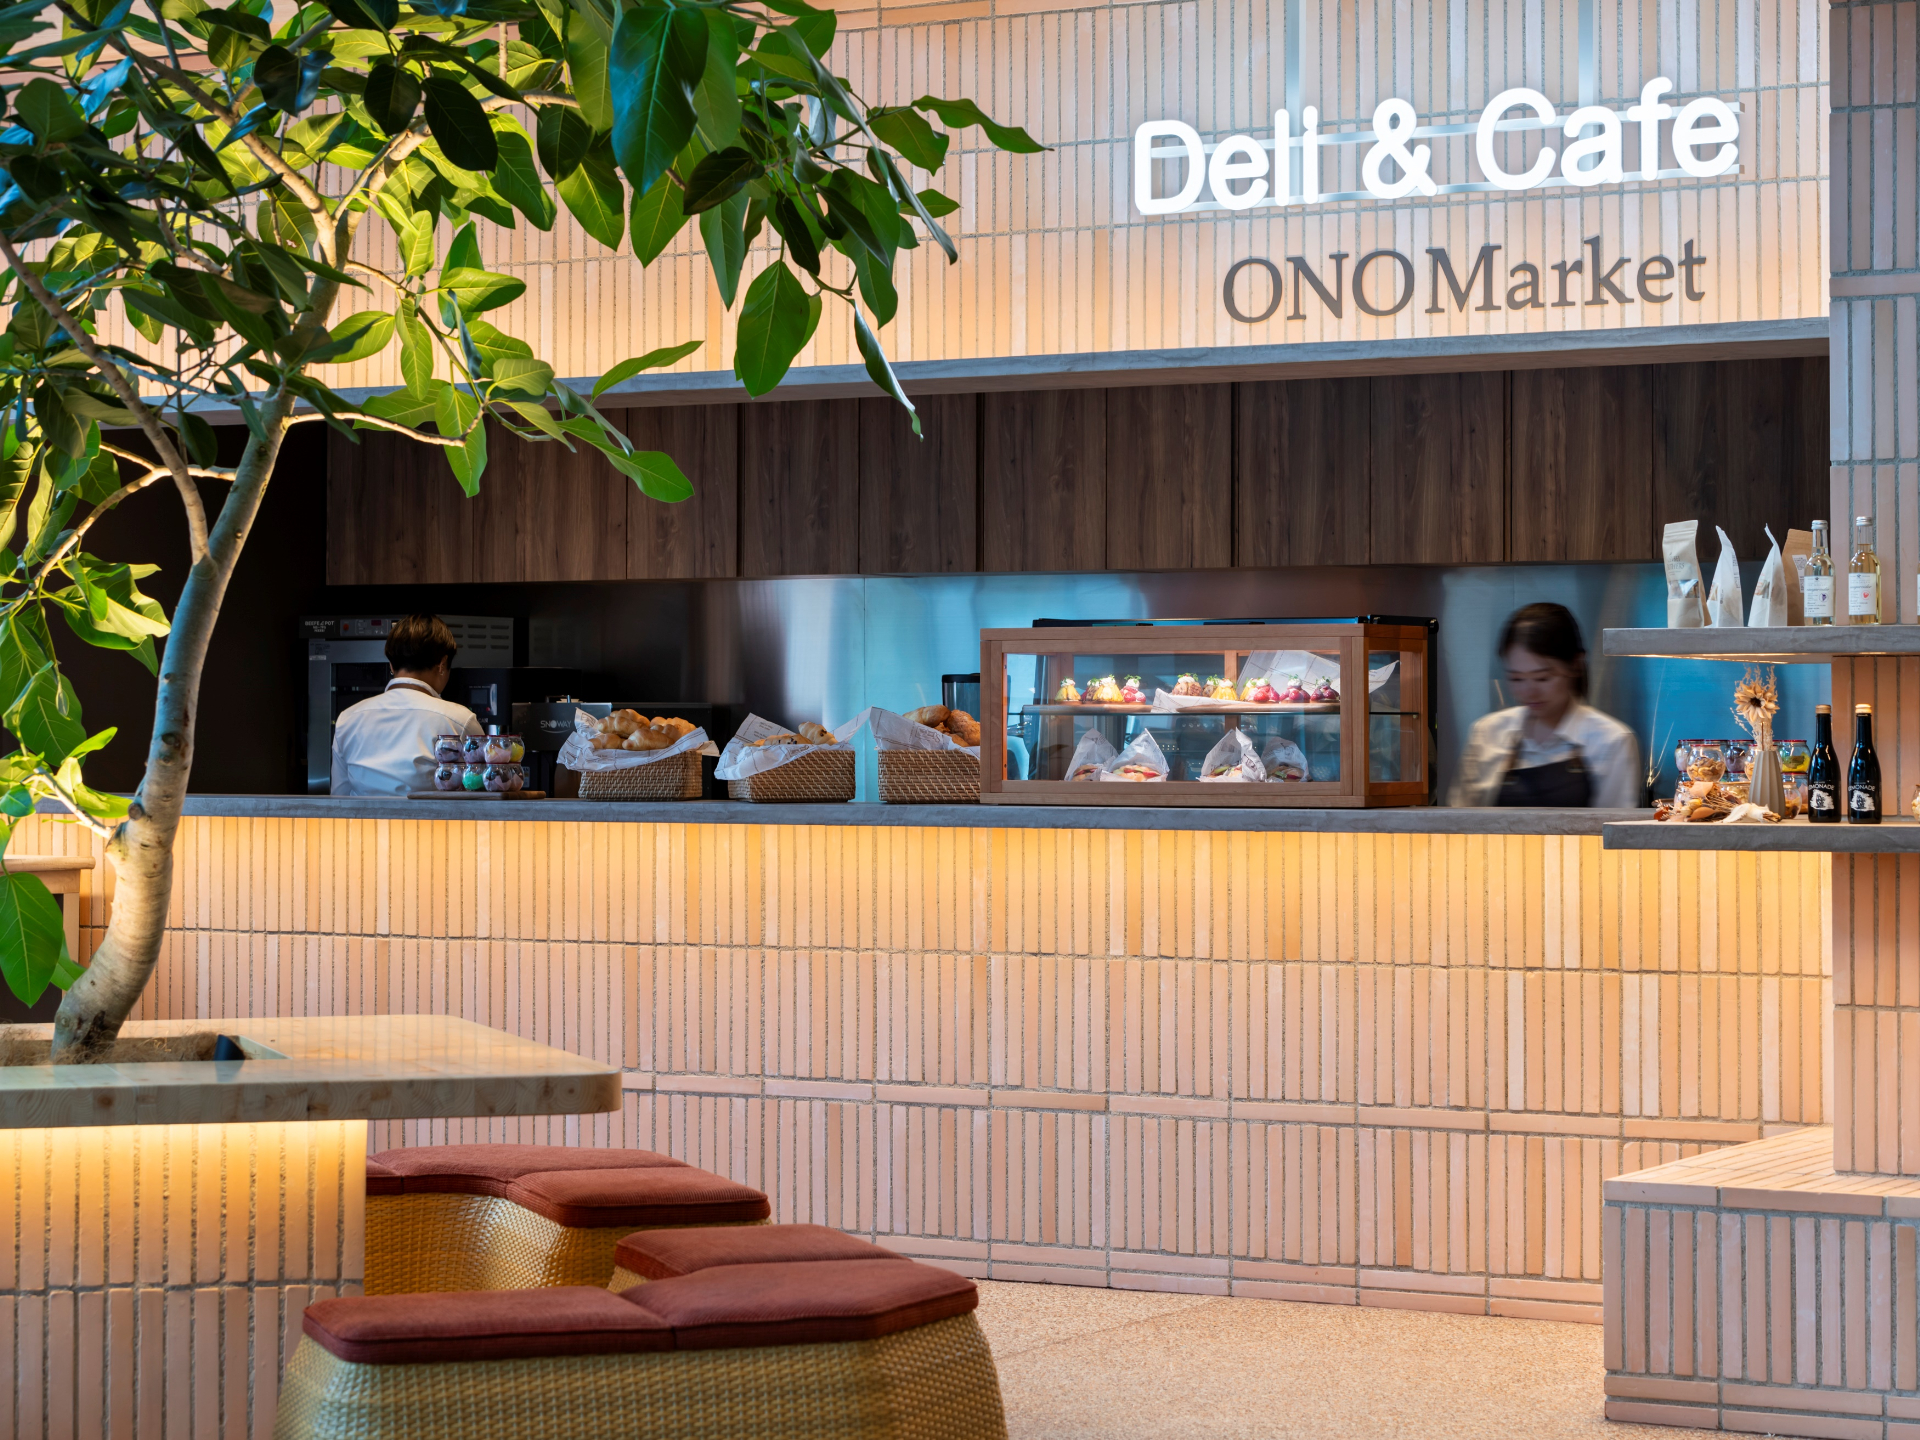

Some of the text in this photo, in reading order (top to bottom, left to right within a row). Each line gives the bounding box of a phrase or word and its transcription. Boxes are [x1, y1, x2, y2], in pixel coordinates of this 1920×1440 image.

[1134, 76, 1740, 214] Deli & Cafe
